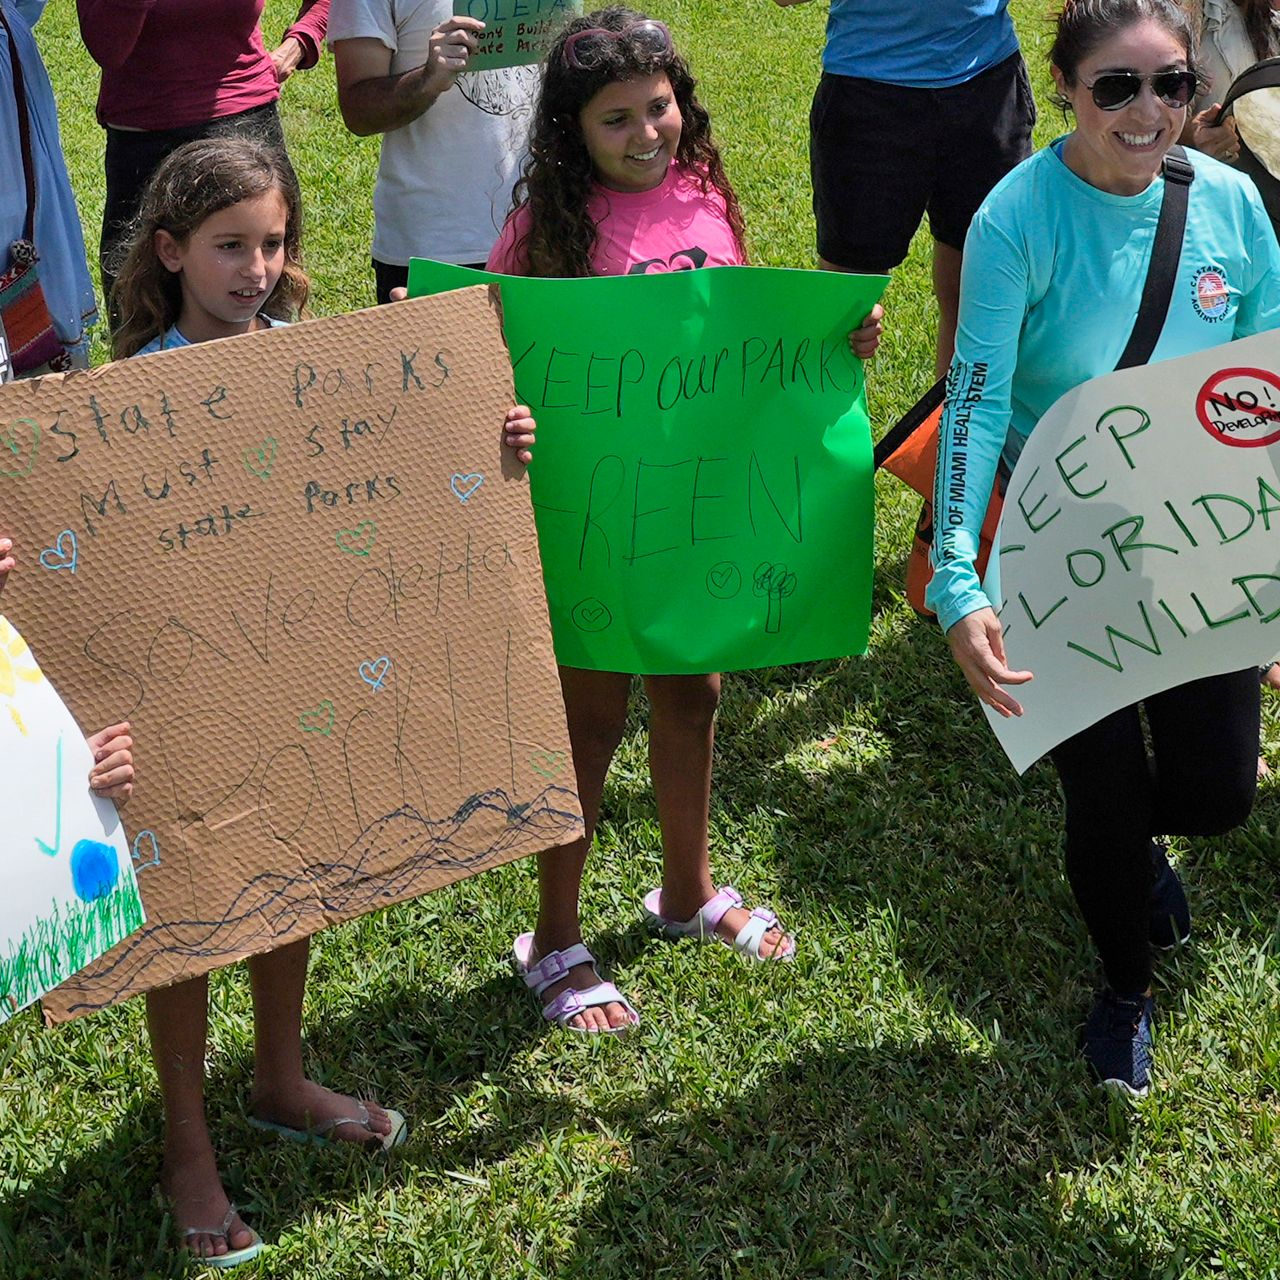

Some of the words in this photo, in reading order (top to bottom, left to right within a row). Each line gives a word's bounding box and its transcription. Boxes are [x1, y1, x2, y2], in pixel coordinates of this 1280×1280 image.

[1190, 298, 1218, 324] AGAINST
[657, 343, 730, 412] our
[1209, 386, 1277, 417] NO!
[48, 384, 236, 463] State
[79, 447, 221, 537] Must
[533, 449, 807, 571] REEN
[949, 450, 968, 505] MIAMI
[1001, 405, 1152, 550] EEP
[947, 506, 965, 527] OF
